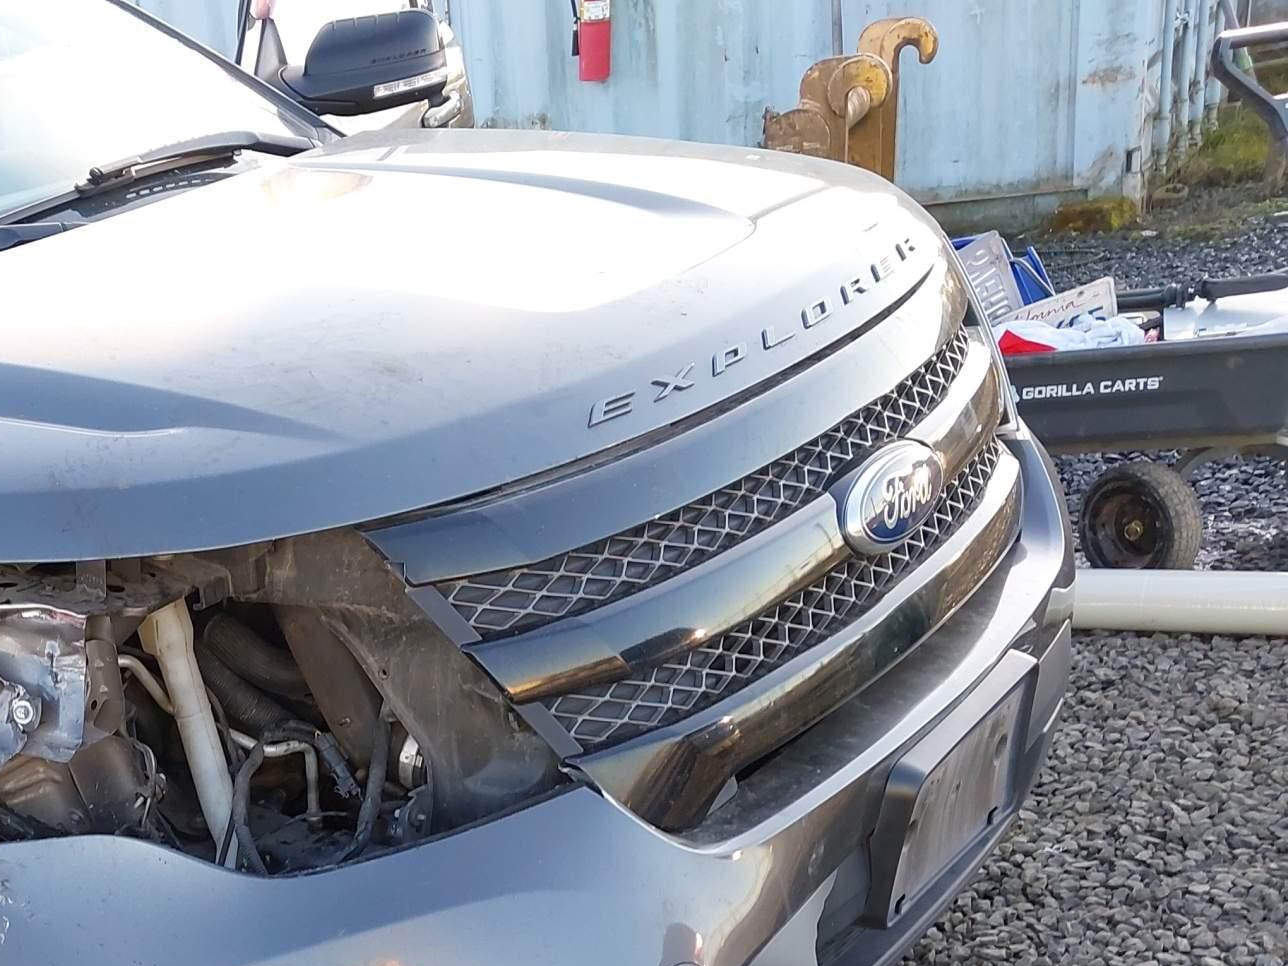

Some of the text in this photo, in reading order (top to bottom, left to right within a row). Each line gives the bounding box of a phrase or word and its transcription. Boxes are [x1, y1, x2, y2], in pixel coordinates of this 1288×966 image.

[588, 238, 916, 428] EXPLORER
[1022, 376, 1160, 400] GORILLA CARTS
[882, 463, 932, 529] Ford
